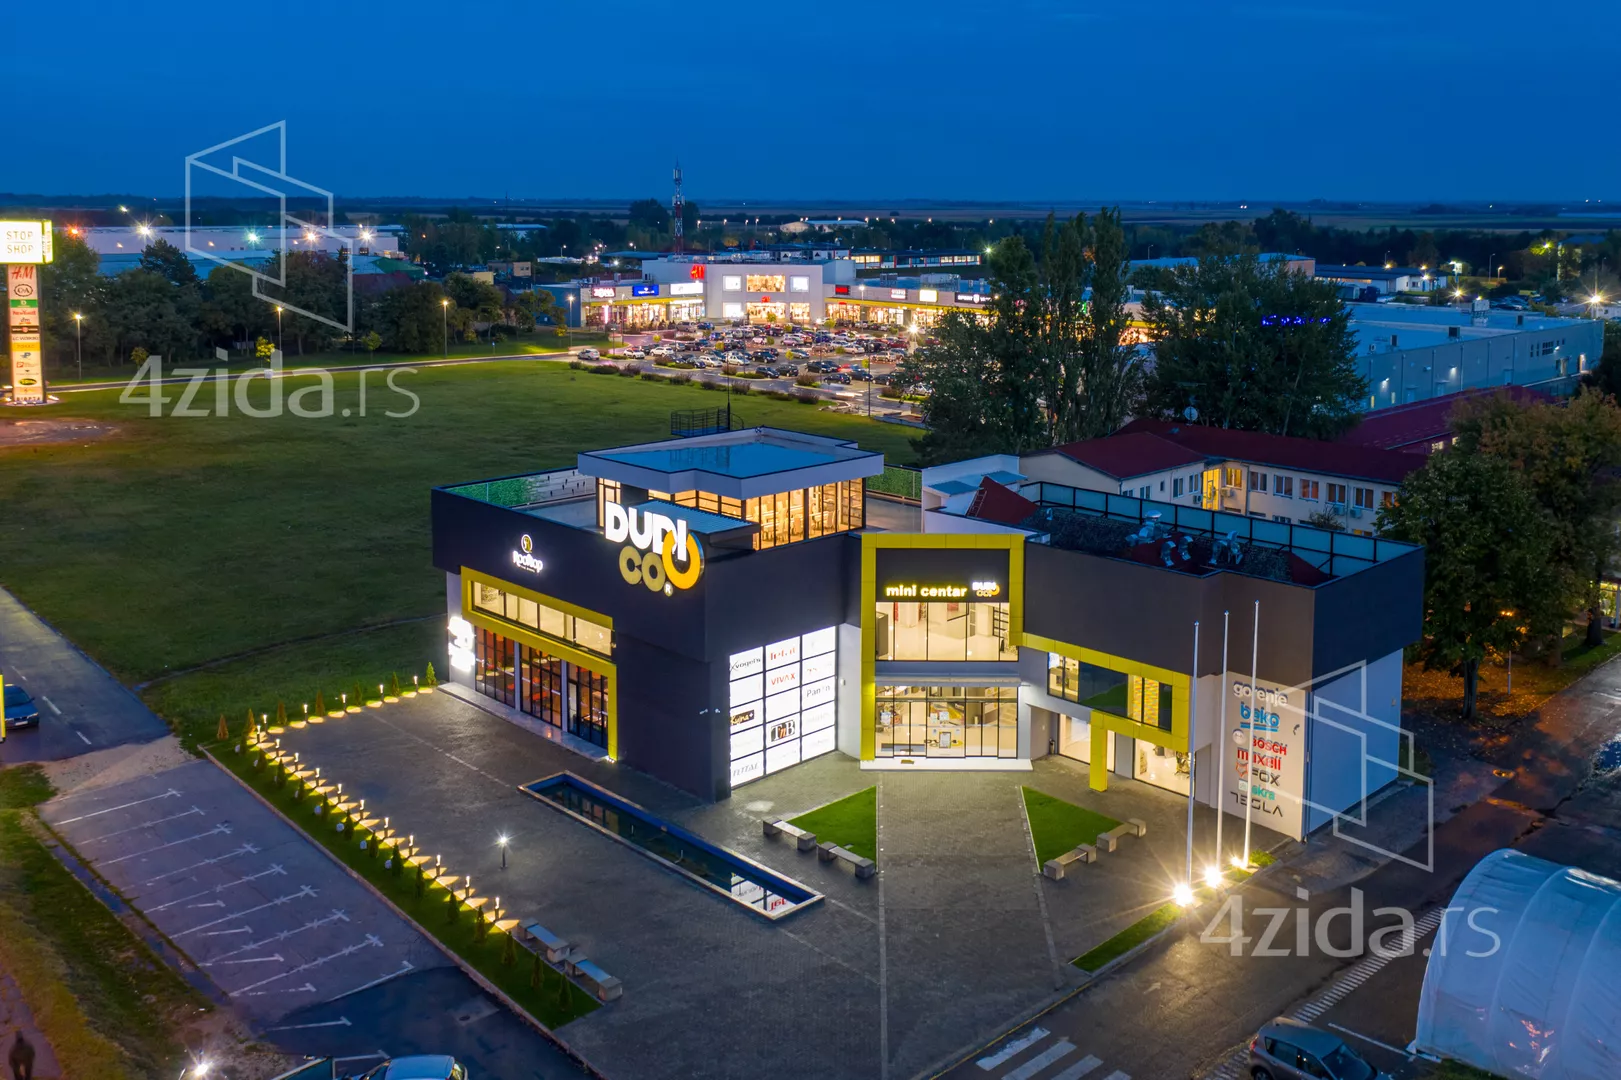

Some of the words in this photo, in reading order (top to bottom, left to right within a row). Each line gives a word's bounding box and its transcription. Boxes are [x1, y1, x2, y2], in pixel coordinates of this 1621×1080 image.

[6, 230, 33, 241] STOP
[7, 244, 34, 254] SHOP
[605, 500, 687, 562] DUDI
[886, 584, 917, 597] mini
[920, 585, 968, 598] centar
[771, 673, 796, 687] VIVAX
[1230, 791, 1283, 818] TESLA
